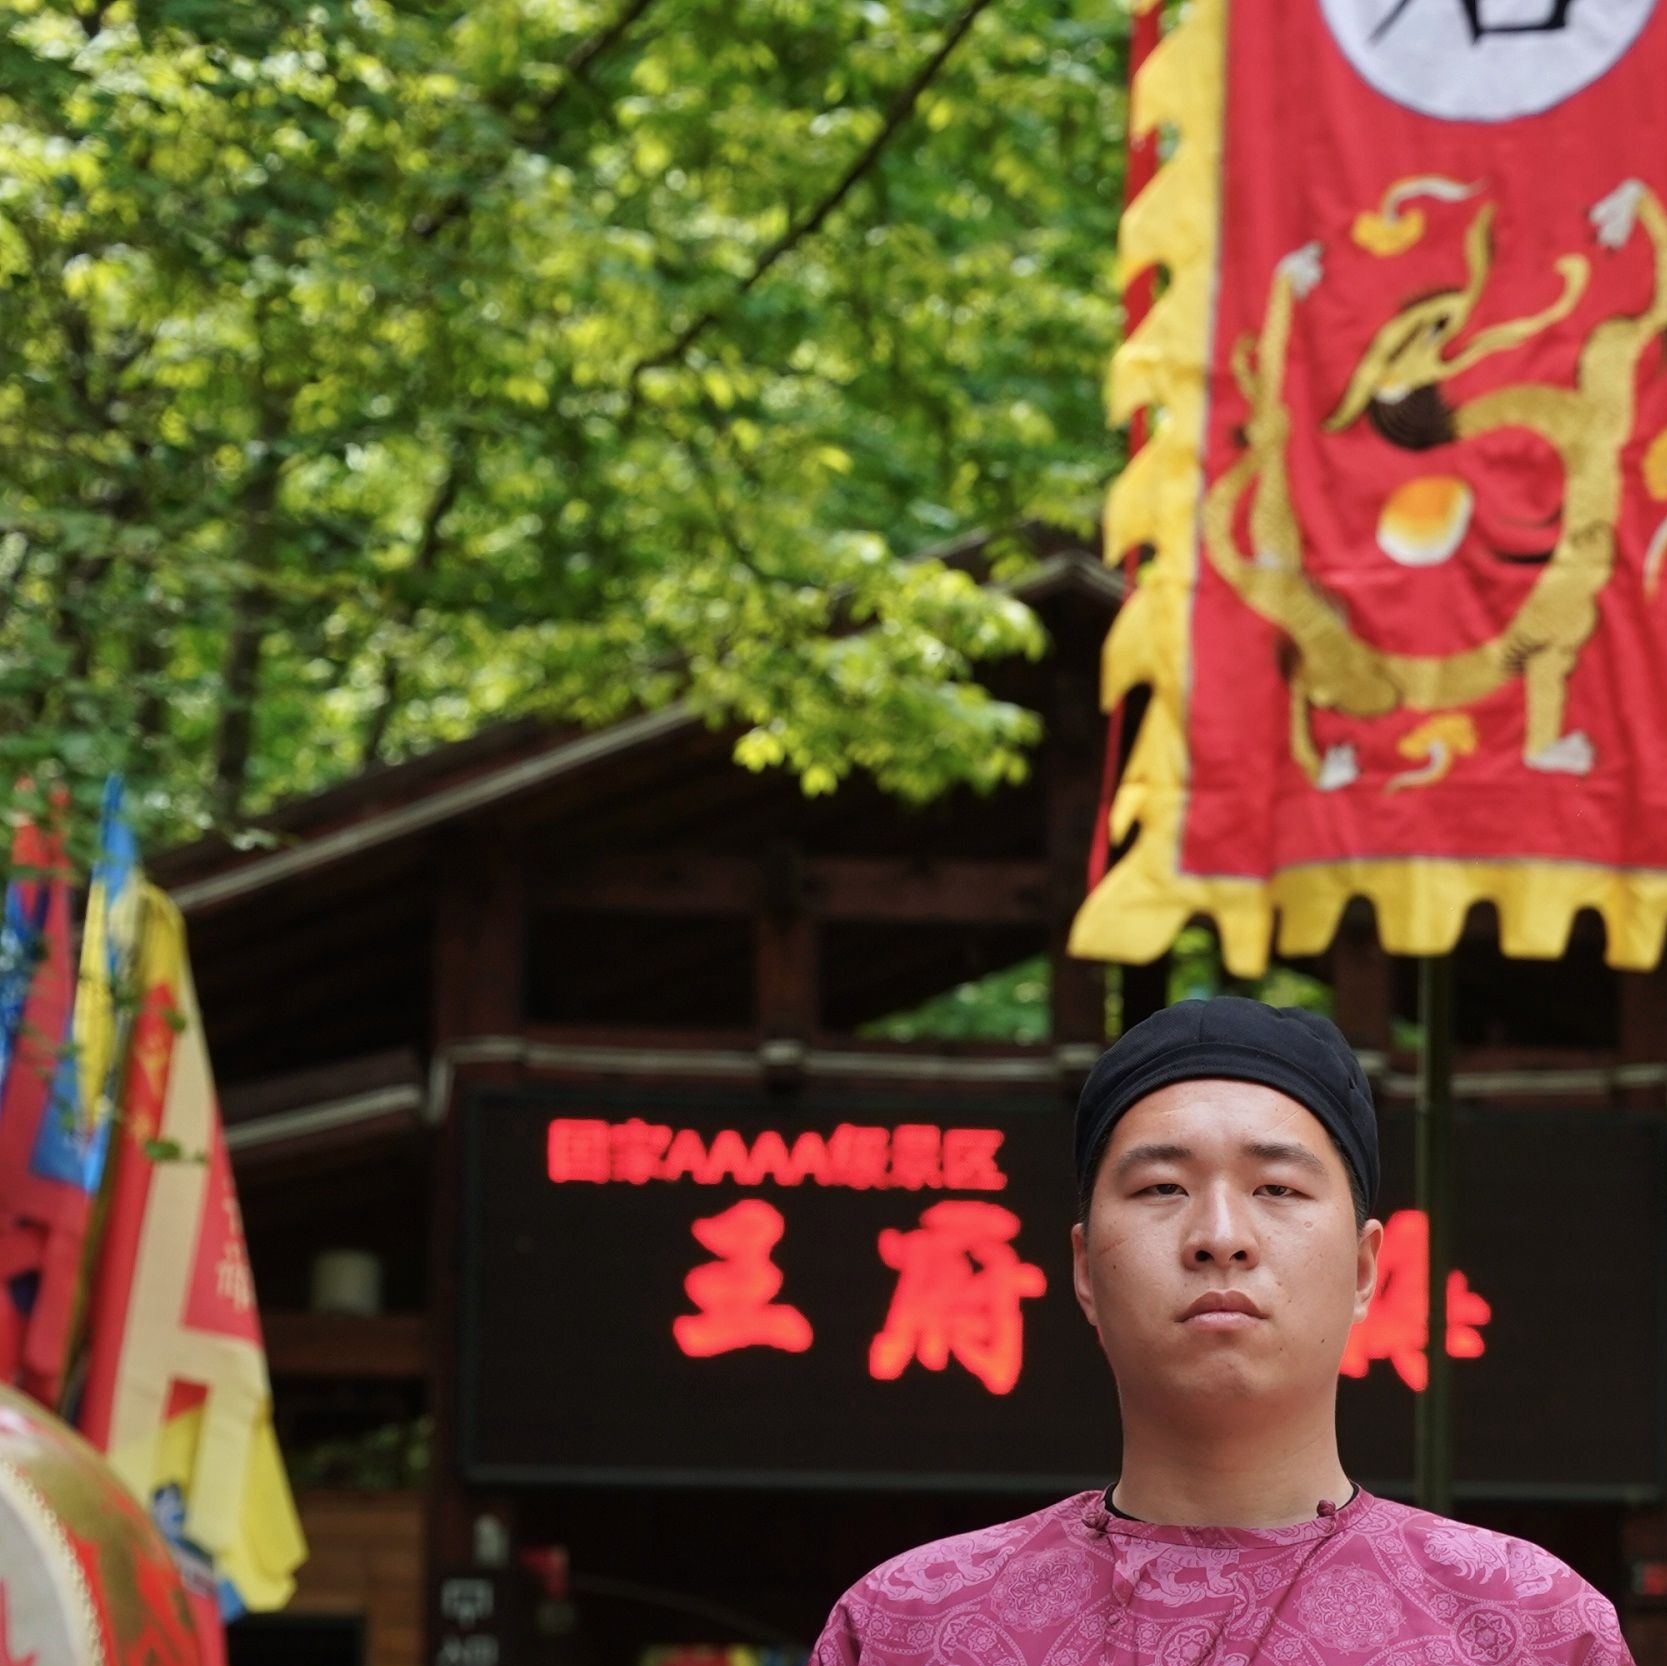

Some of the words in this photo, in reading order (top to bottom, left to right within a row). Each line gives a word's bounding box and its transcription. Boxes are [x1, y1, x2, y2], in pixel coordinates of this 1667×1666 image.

[548, 1118, 1007, 1190] 国家AAAA级景区
